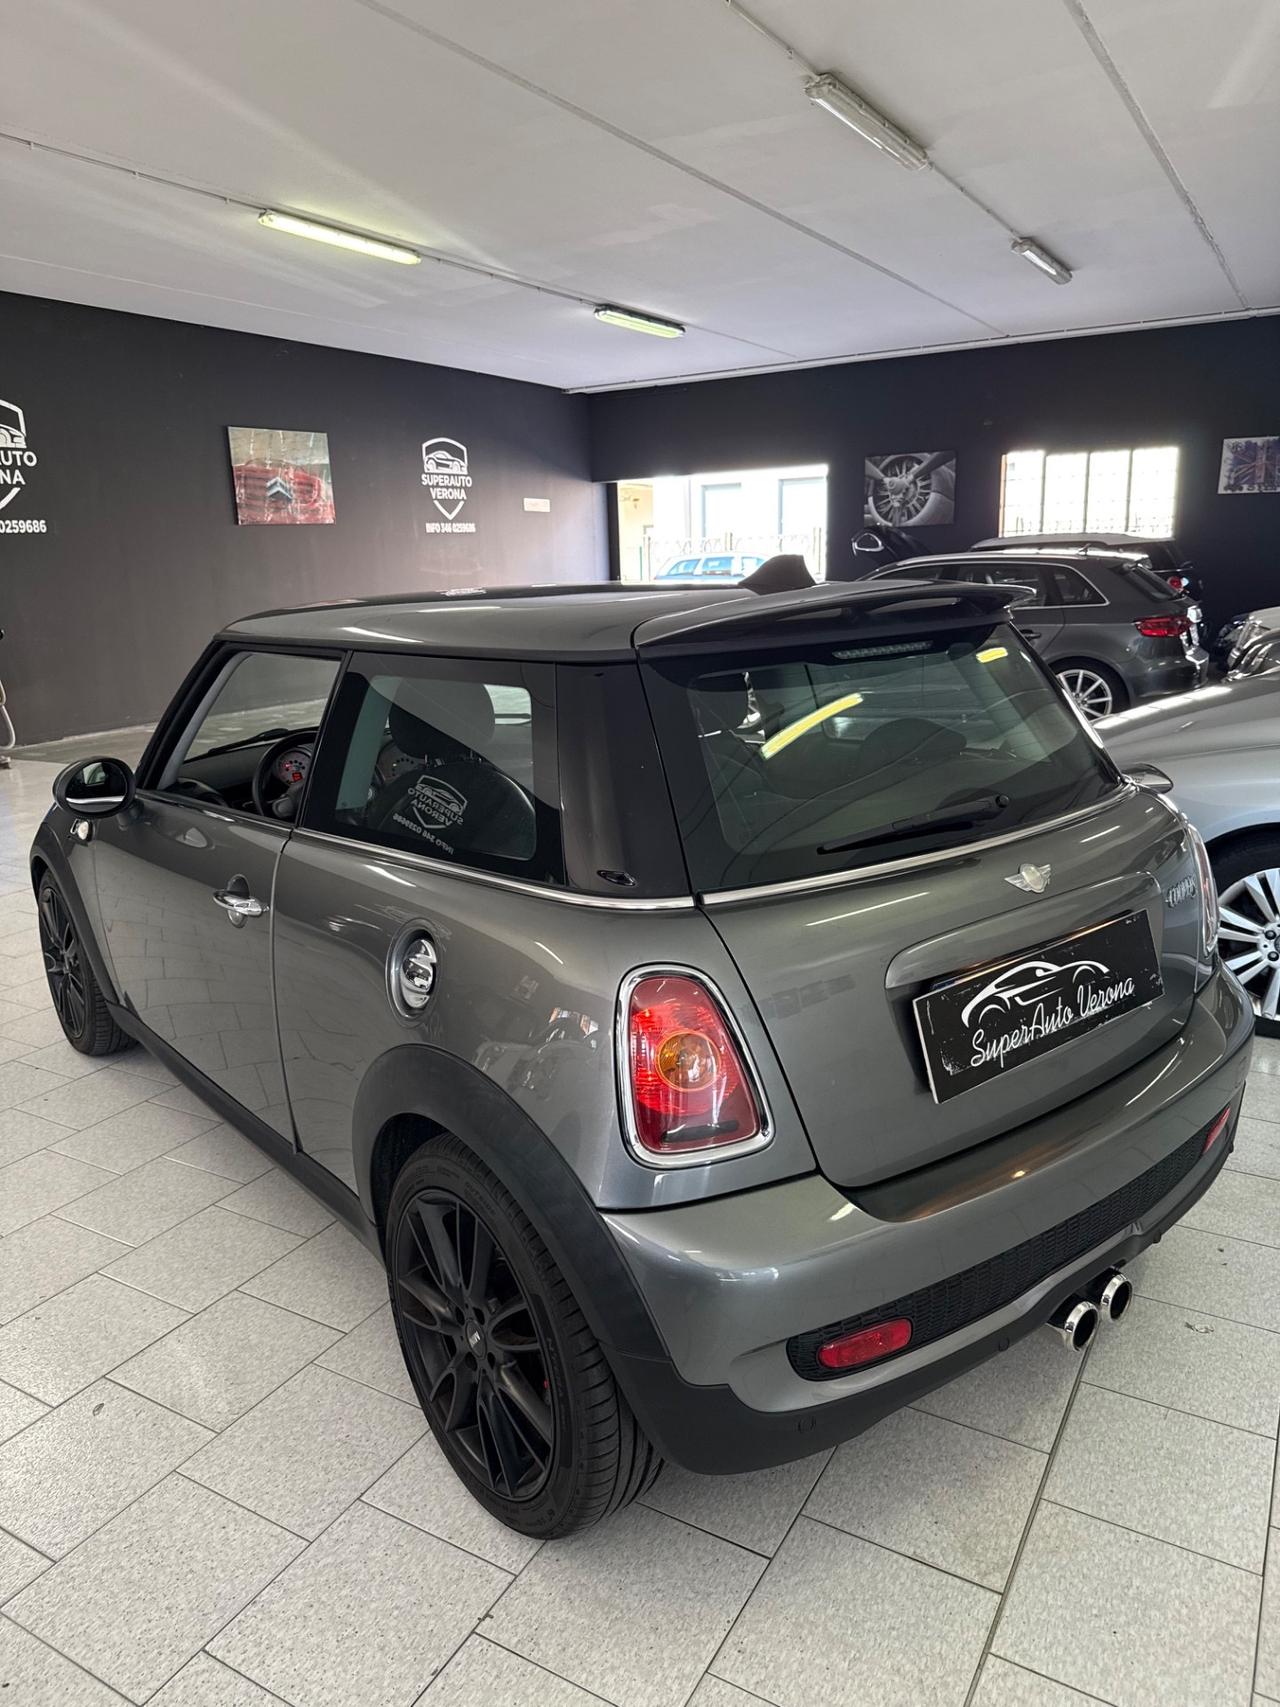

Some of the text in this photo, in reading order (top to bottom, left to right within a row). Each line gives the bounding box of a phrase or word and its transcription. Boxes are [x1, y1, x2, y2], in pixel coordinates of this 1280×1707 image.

[0, 450, 38, 467] UTO
[421, 473, 473, 487] SUPERAUTO
[430, 487, 467, 500] VERONA
[0, 519, 47, 533] 0259686
[970, 977, 1135, 1068] SuperAuto Verona
